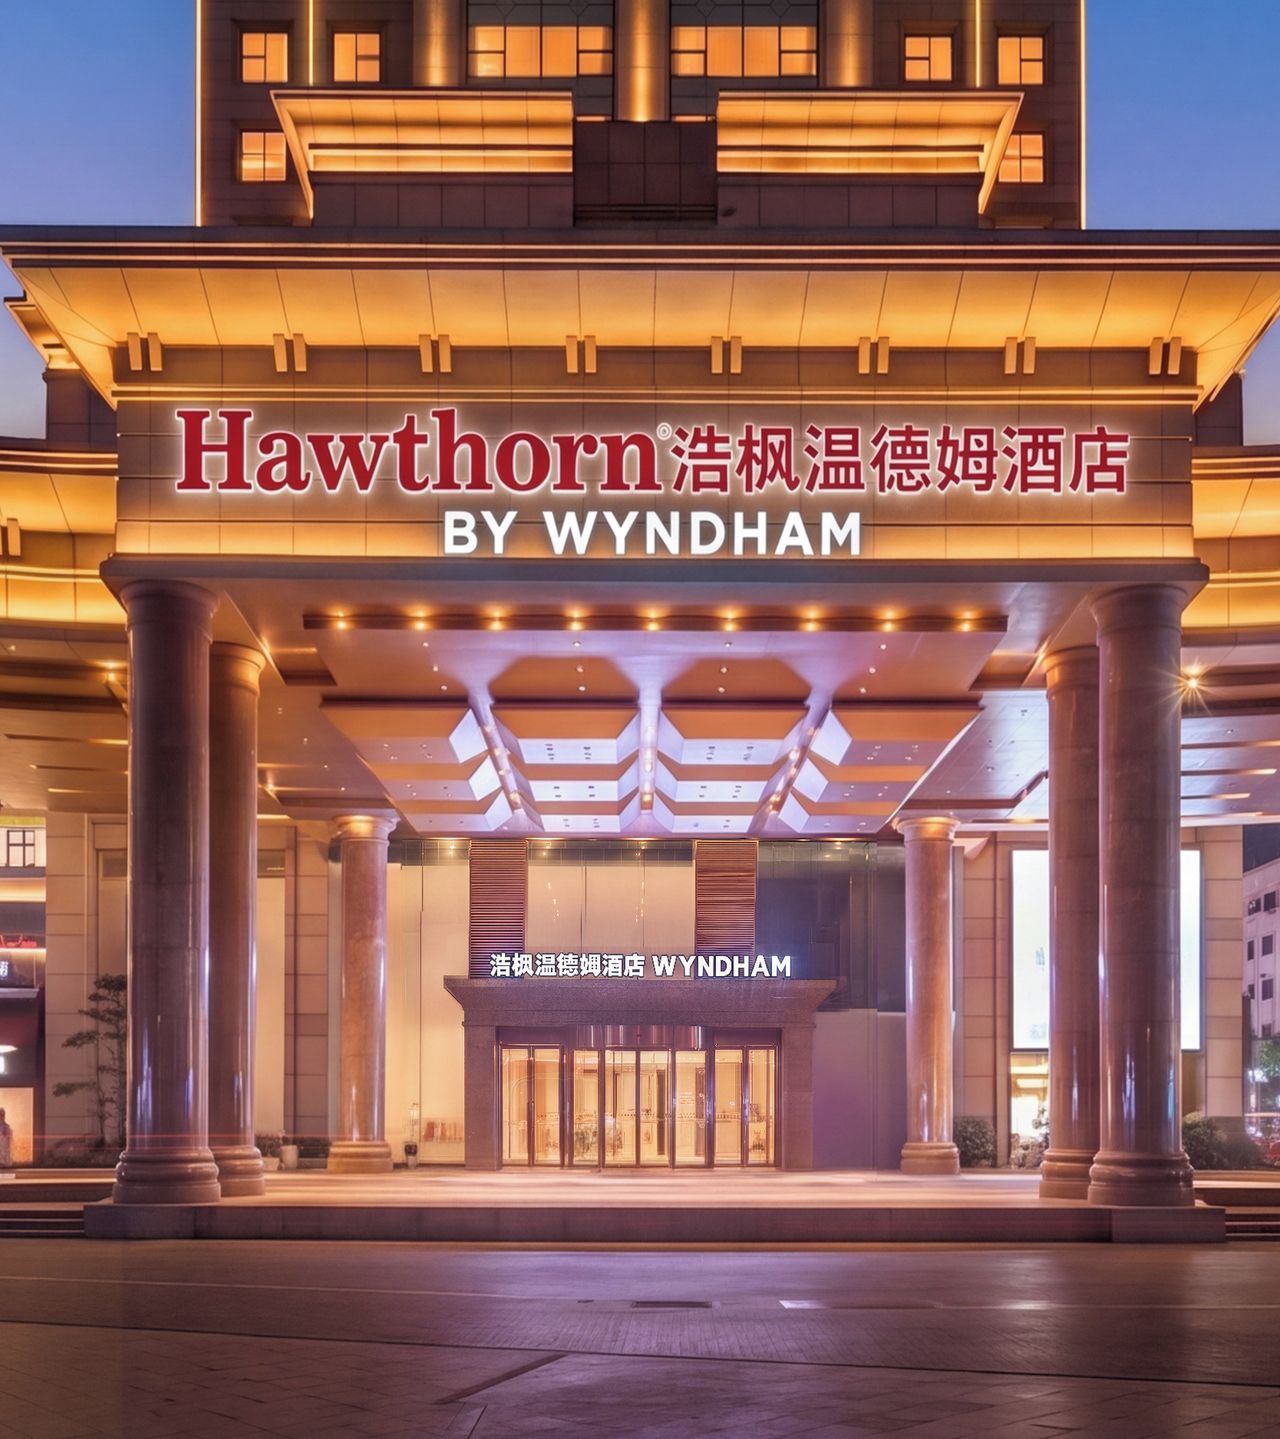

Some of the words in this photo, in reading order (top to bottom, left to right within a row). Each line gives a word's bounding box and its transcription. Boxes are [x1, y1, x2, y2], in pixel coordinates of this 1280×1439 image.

[175, 408, 663, 492] Hawthorn
[670, 425, 1128, 494] 浩枫温德姆酒店
[443, 511, 518, 555] BY
[543, 511, 861, 556] WYNDHAM
[652, 955, 791, 977] WYNDHAM
